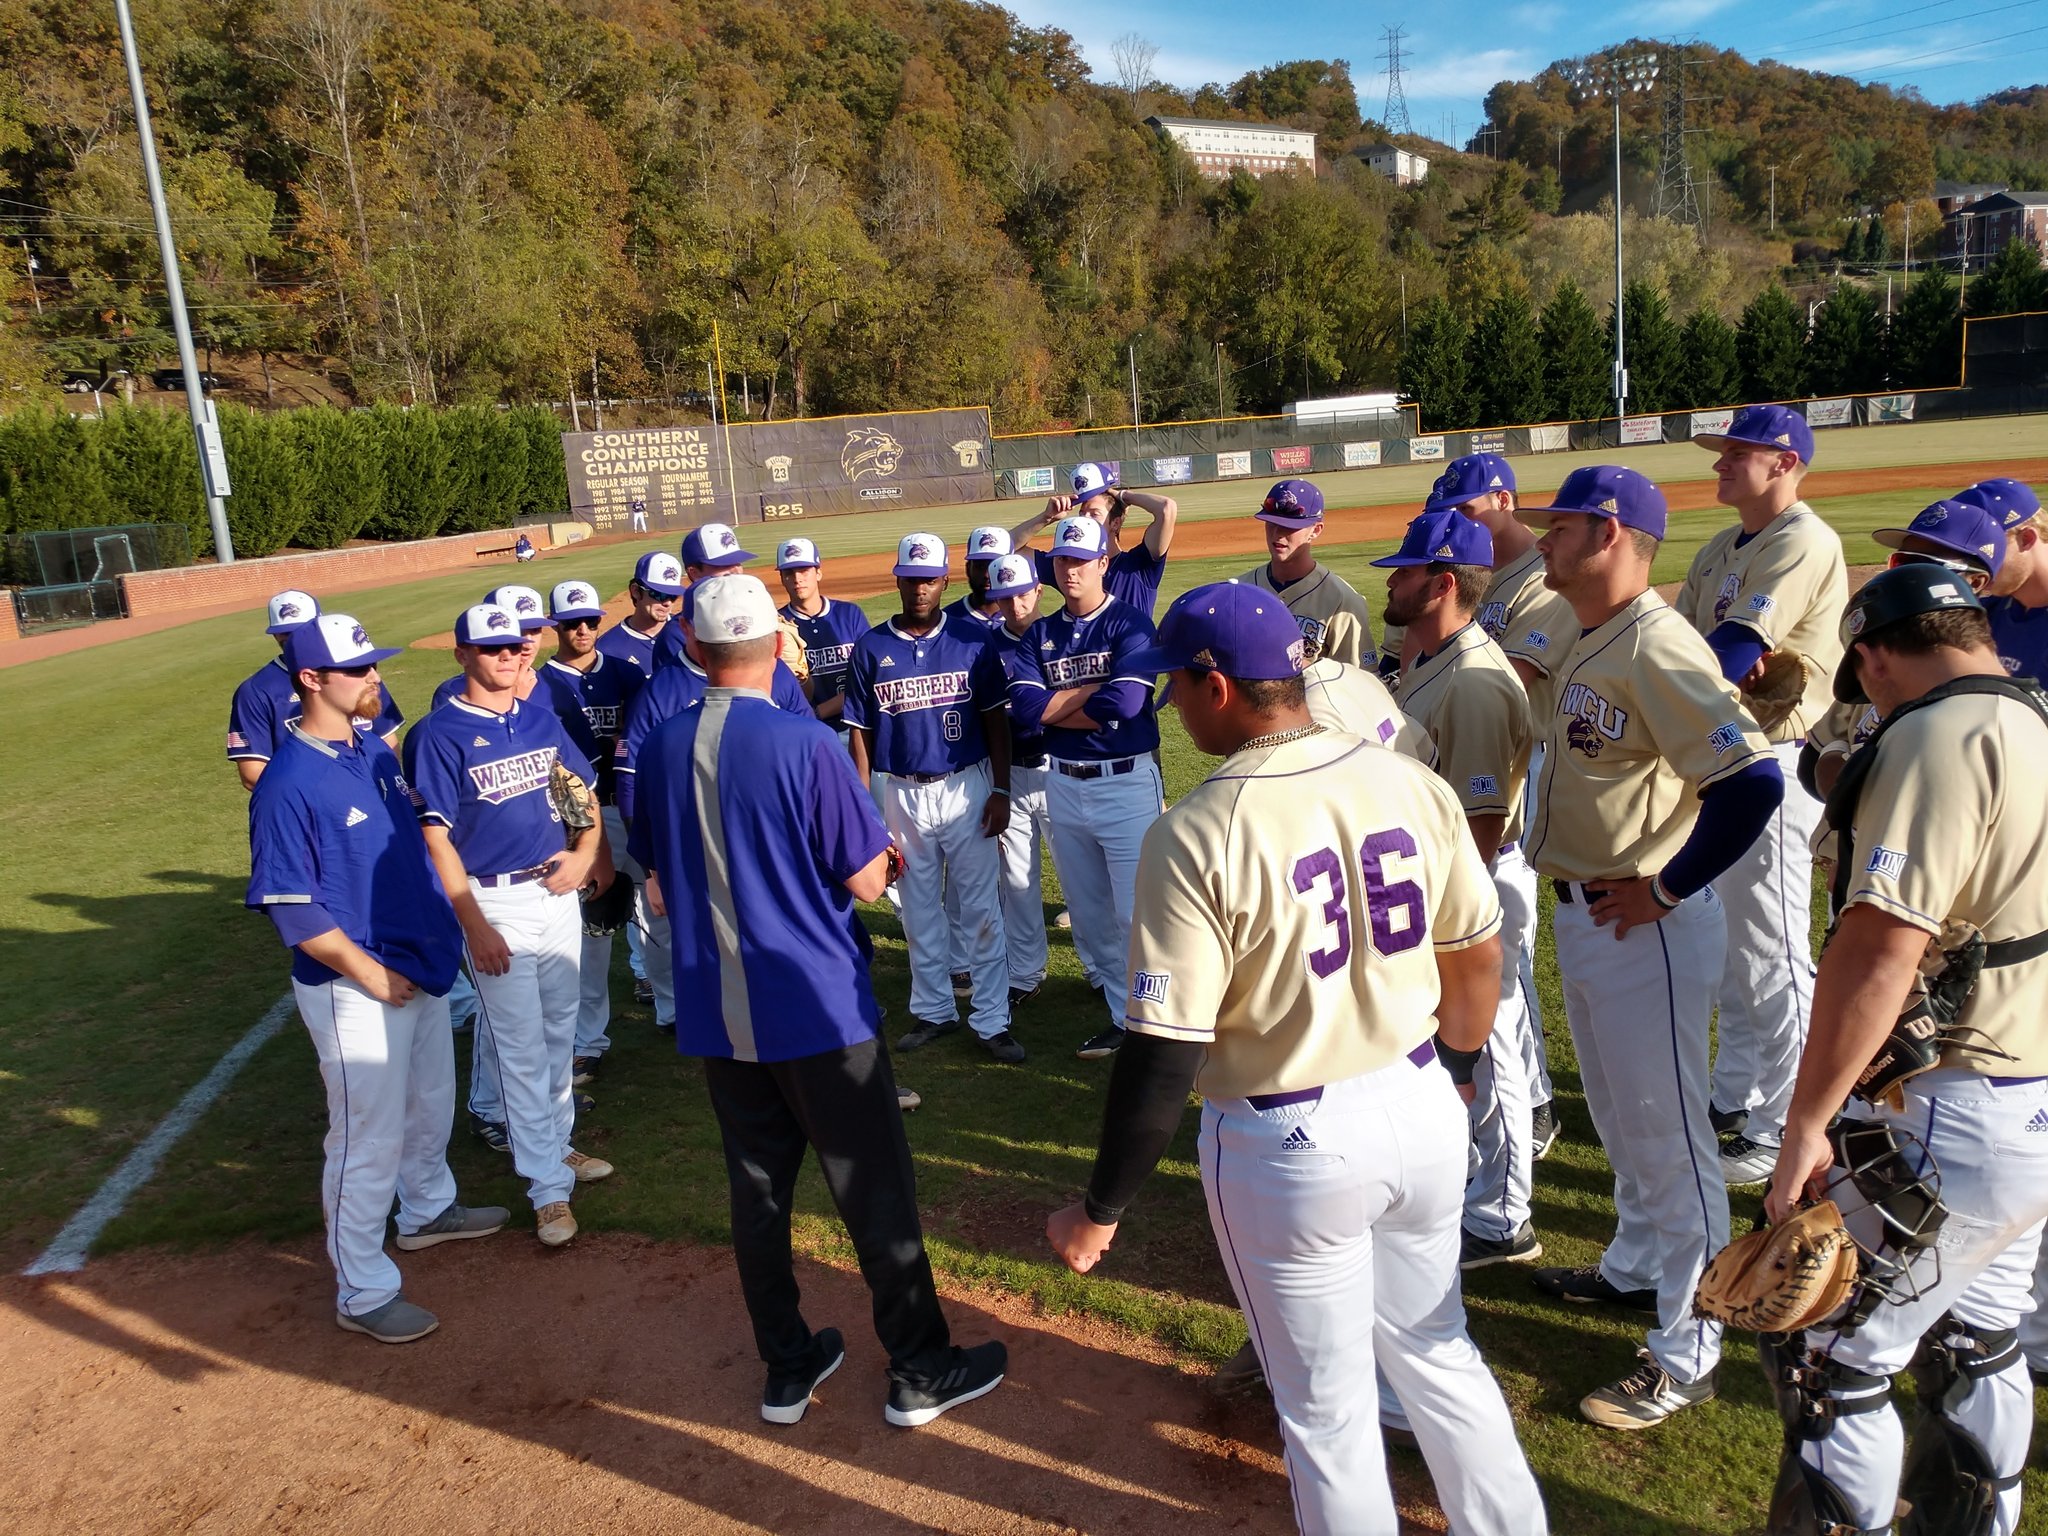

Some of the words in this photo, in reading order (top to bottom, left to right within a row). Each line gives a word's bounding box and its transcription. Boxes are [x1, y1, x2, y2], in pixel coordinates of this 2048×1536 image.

[1693, 421, 1720, 429] aramark
[593, 430, 700, 448] SOUTHERN
[581, 443, 709, 463] CONFERENCE
[966, 453, 973, 464] 7
[1280, 451, 1305, 459] WELLS
[585, 456, 707, 476] CHAMPIONS
[1155, 457, 1190, 465] RIDENOUR
[1281, 457, 1305, 465] FARGO
[661, 472, 709, 483] TOURNAMENT
[774, 468, 786, 478] 23
[586, 478, 618, 489] REGULAR
[620, 476, 649, 486] SEASON
[699, 497, 715, 505] 2003
[613, 512, 629, 520] 2007
[765, 503, 804, 517] 325
[1747, 593, 1778, 617] SOCO
[874, 672, 969, 705] WESTERN
[895, 699, 933, 711] CAROLINA
[1563, 683, 1628, 741] WCU
[943, 710, 962, 741] 8
[470, 747, 557, 791] WESTER
[500, 779, 539, 797] CAROLINA
[1866, 847, 1907, 881] CON
[1290, 826, 1427, 981] 36
[1858, 1053, 1896, 1086] Wilson
[2025, 1121, 2048, 1133] adid
[1282, 1142, 1317, 1150] adidas
